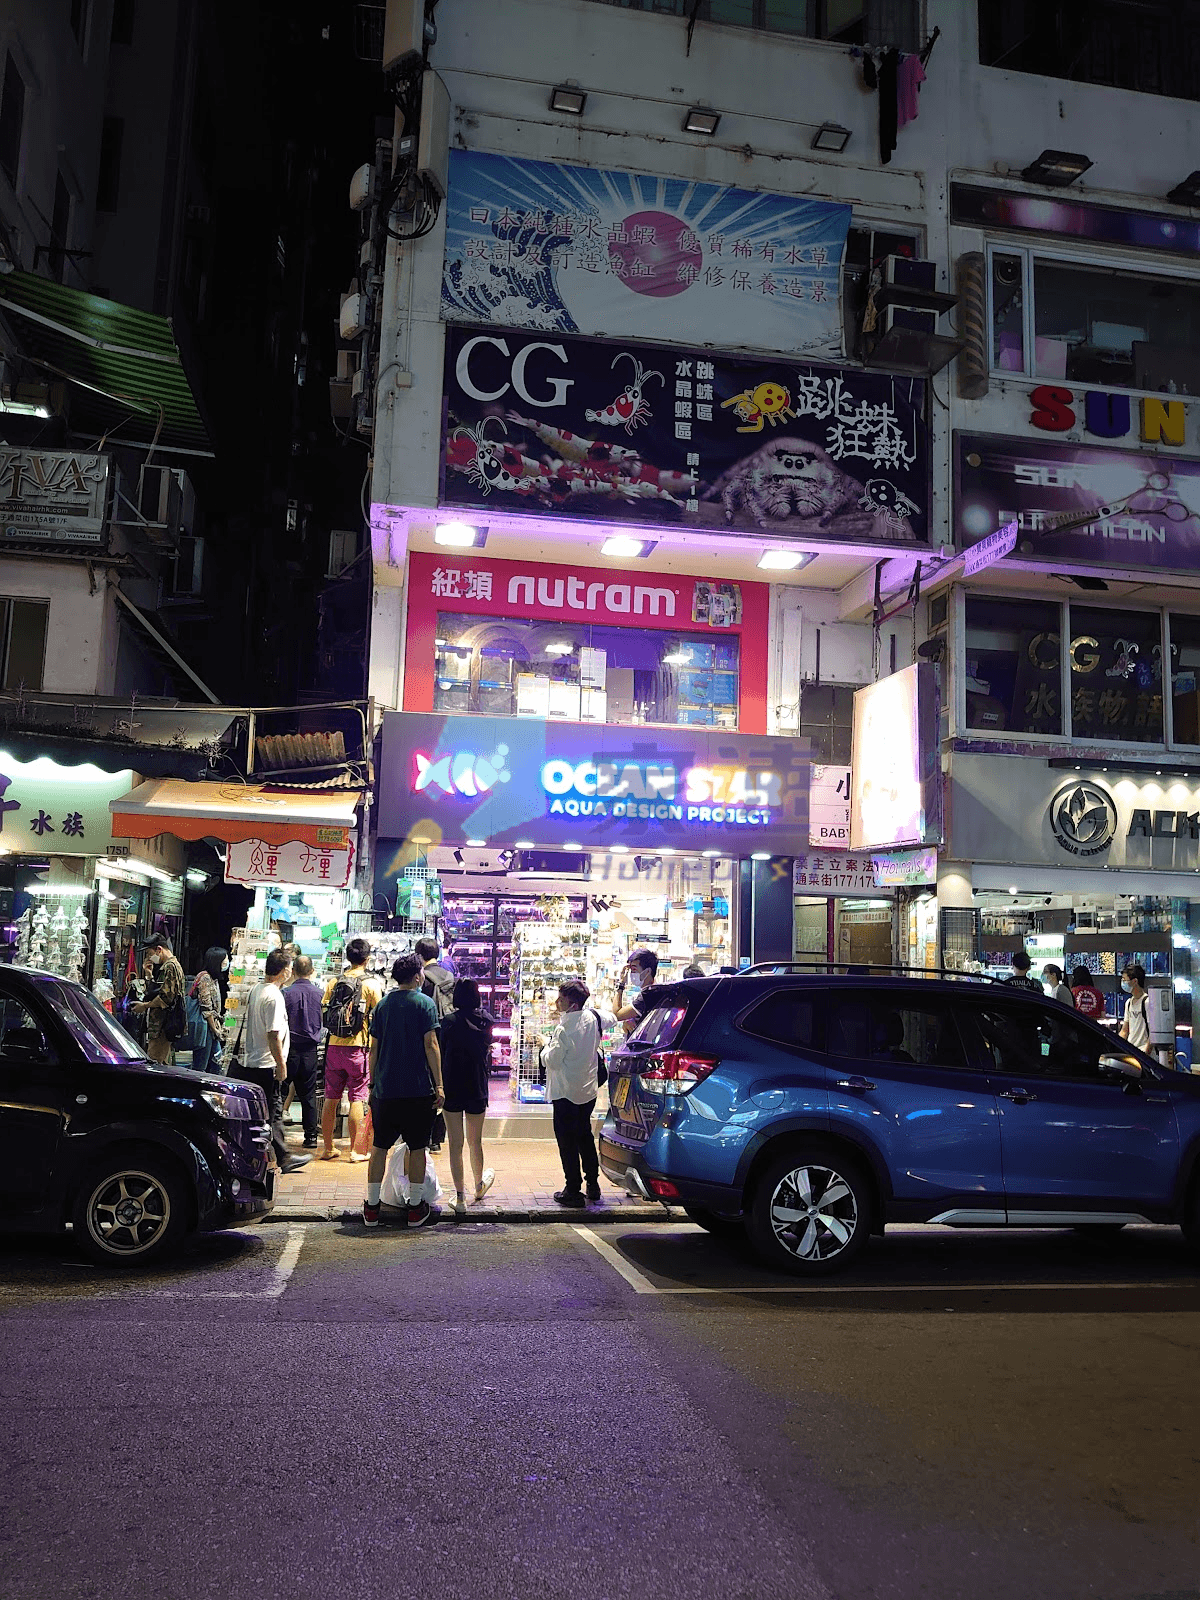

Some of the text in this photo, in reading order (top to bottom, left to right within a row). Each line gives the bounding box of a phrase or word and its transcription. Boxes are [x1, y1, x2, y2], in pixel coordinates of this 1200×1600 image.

[470, 206, 829, 270] 日本純種水晶蝦 優質稀有水草
[465, 238, 829, 302] 設計及訂造魚缸 維修保養造景
[455, 335, 575, 408] CG
[674, 360, 693, 441] 水晶蝦區
[695, 361, 715, 421] 跳蛛區
[1029, 385, 1185, 446] SUN
[507, 575, 676, 617] nutram
[543, 760, 782, 806] OCEAN STAR
[549, 799, 771, 826] AQUA DESIGN PROJECT
[30, 809, 85, 838] 水族
[106, 845, 128, 855] 175D
